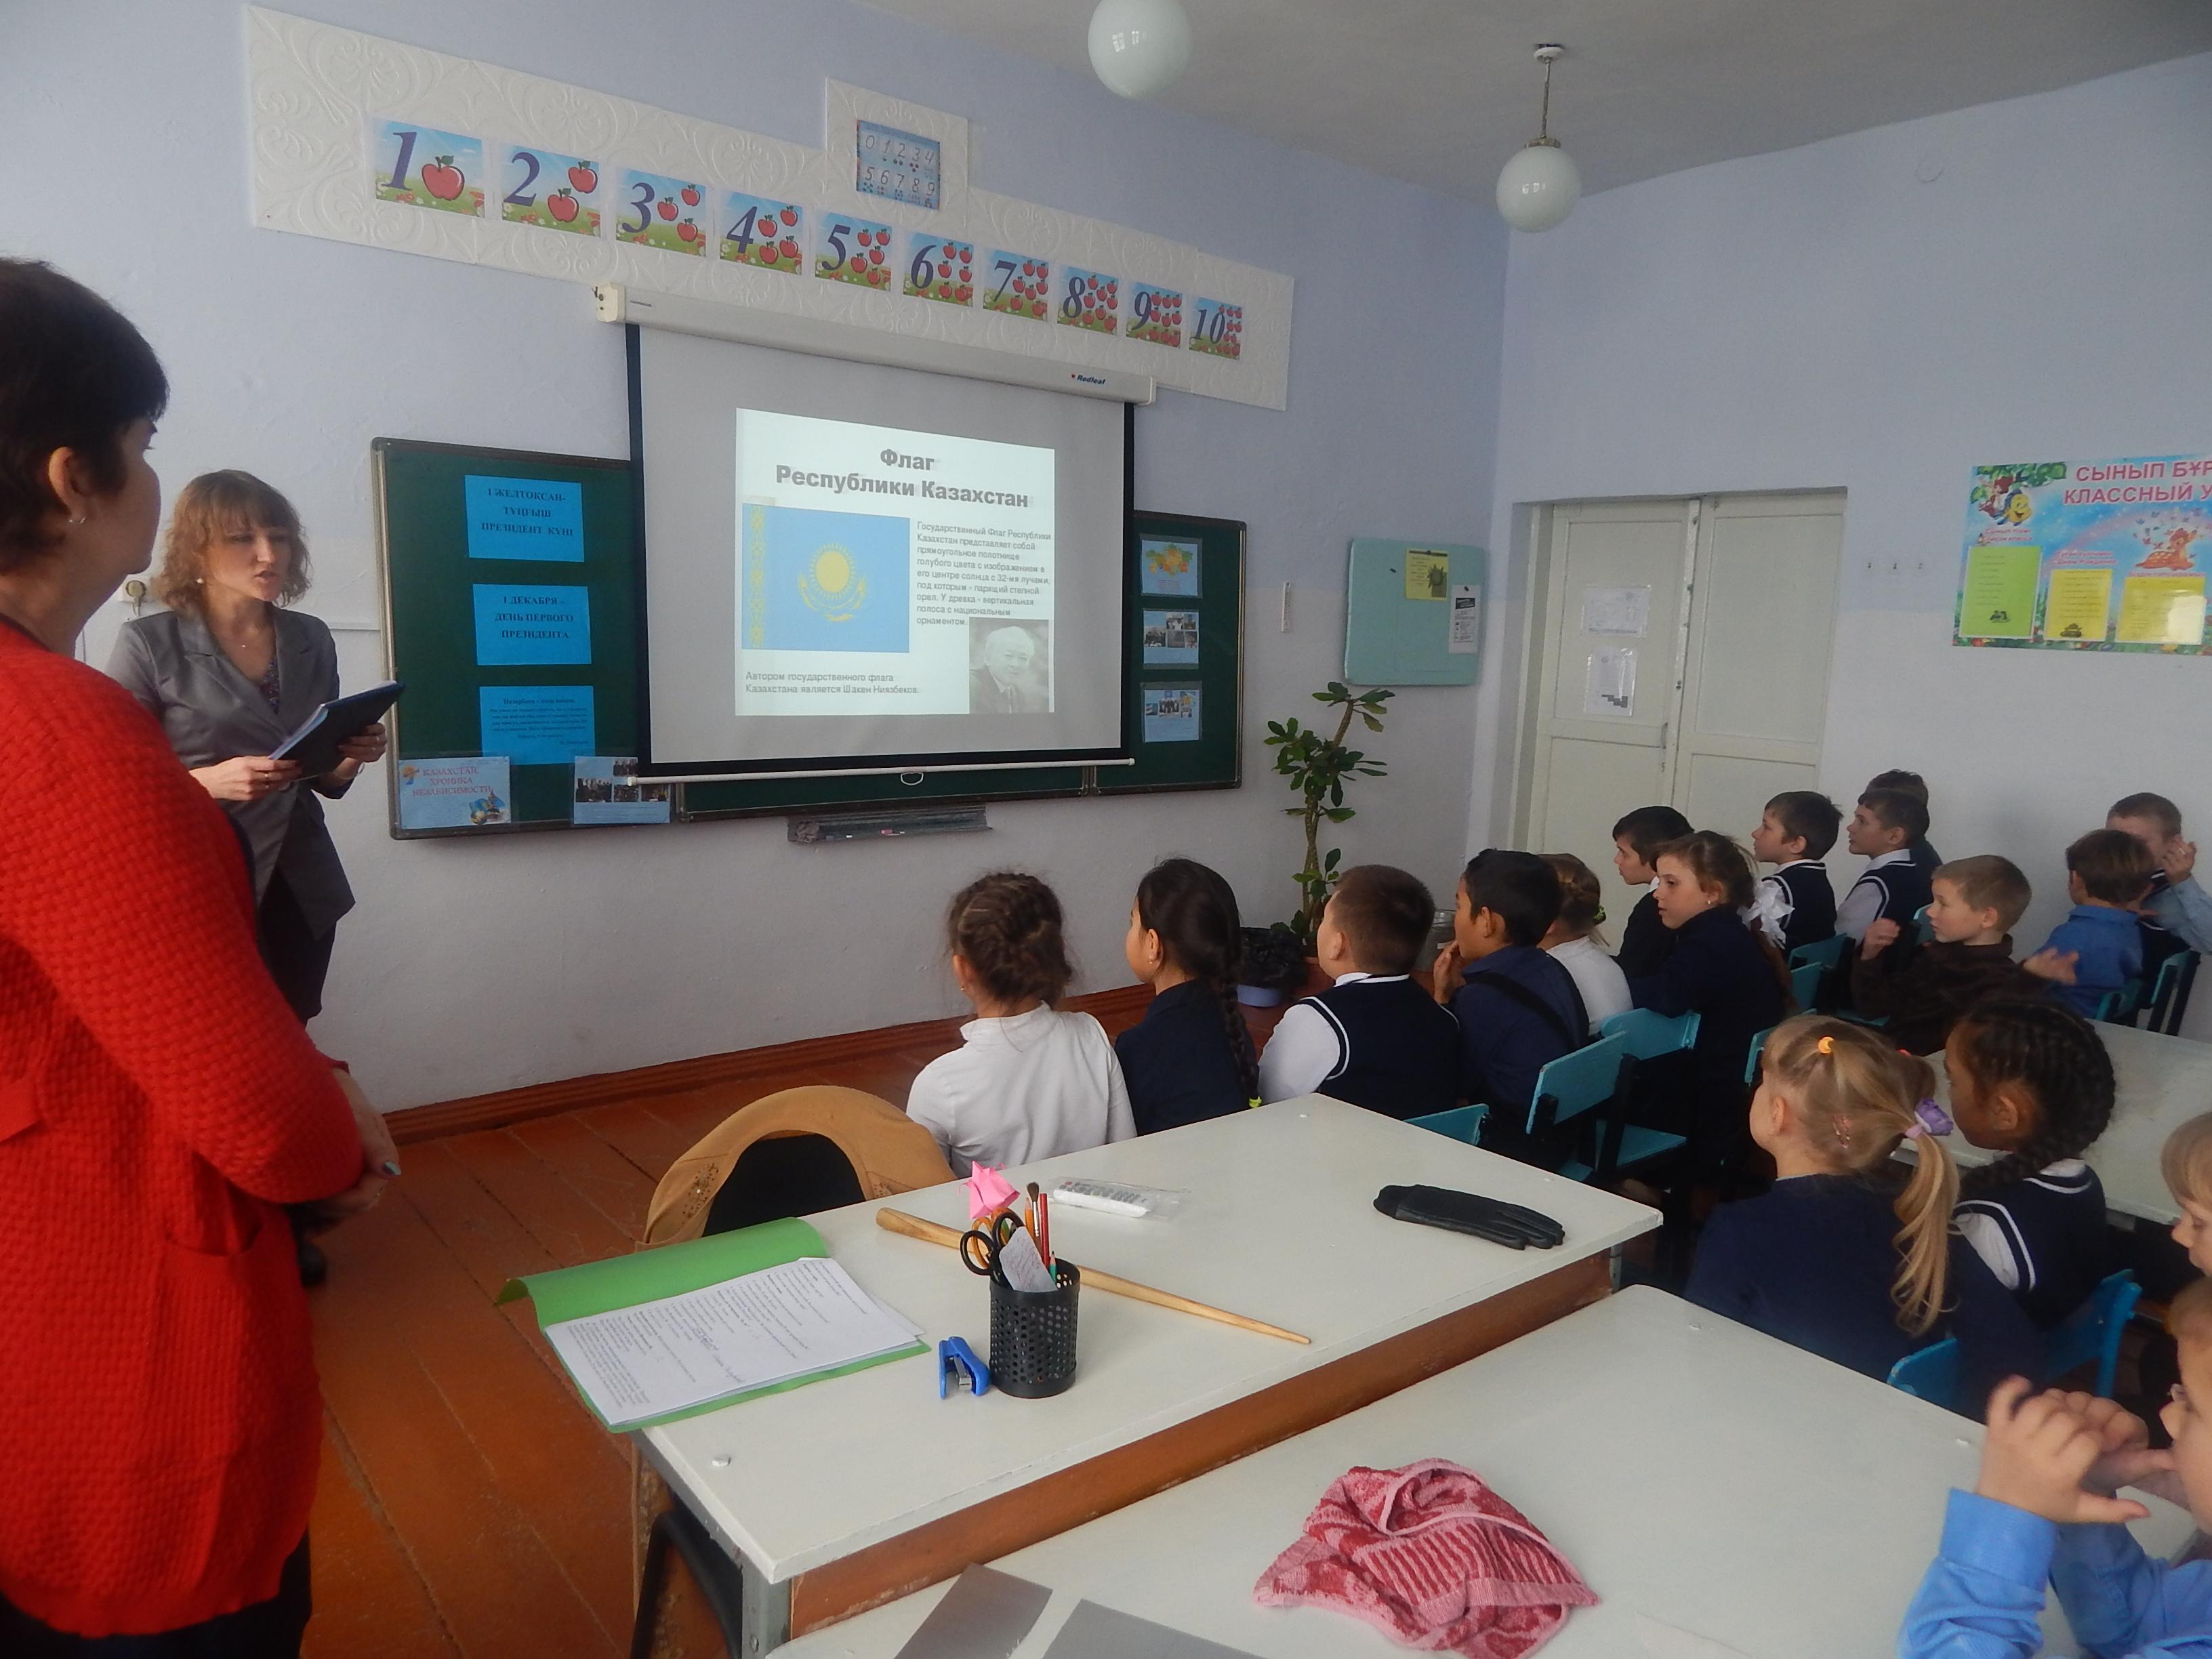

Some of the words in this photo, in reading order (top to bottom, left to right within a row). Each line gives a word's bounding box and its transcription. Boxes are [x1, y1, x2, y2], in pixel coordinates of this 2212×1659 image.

[381, 131, 417, 190] 1
[884, 140, 890, 153] 1
[897, 143, 905, 158] 2
[912, 147, 920, 161] 3
[925, 151, 934, 165] 4
[504, 152, 540, 207] 2
[865, 167, 874, 180] 5
[881, 170, 889, 184] 6
[897, 173, 905, 188] 7
[912, 178, 920, 192] 8
[927, 182, 935, 196] 9
[621, 182, 655, 233] 3
[726, 205, 758, 253] 4
[821, 224, 851, 270] 5
[910, 245, 937, 289] 6
[993, 260, 1017, 302] 7
[1062, 276, 1086, 318] 8
[1132, 291, 1152, 330] 9
[1191, 309, 1225, 345] 10
[1078, 375, 1106, 384] Redleaf
[880, 449, 935, 470] Флаг
[2076, 463, 2165, 481] СЫНЫП
[776, 464, 914, 496] Республики
[922, 480, 1028, 508] Казахстан
[2064, 482, 2193, 504] КЛАССНЫЙ
[917, 521, 986, 535] Государственный
[987, 527, 1006, 537] Флаг
[1008, 529, 1051, 541] Республики
[917, 533, 958, 544] Казахстан
[960, 538, 1011, 548] представляет
[1012, 541, 1036, 550] собой
[917, 546, 976, 557] прямоугольное
[978, 551, 1020, 561] полотнище
[917, 558, 951, 568] голубого
[954, 561, 975, 570] цвета
[984, 562, 1038, 573] изображением
[932, 571, 960, 581] центре
[961, 573, 989, 581] солнца
[997, 574, 1019, 583] 32-мя
[917, 582, 932, 590] под
[934, 583, 966, 592] которым
[974, 585, 1008, 594] парящий
[1010, 587, 1040, 595] степной
[510, 596, 558, 605] ДЕКАБРЯ
[917, 594, 938, 602] орел.
[941, 593, 946, 601] У
[949, 595, 976, 604] древка
[983, 597, 1034, 606] вертикальная
[495, 613, 523, 622] ДЕНЬ
[526, 613, 574, 622] ПЕРВОГО
[917, 605, 945, 613] полоса
[954, 607, 1010, 616] национальным
[917, 617, 967, 626] орнаментом.
[501, 630, 569, 639] ПРЕЗИДЕНТА
[745, 671, 785, 682] Автором
[788, 674, 866, 683] государственного
[868, 674, 894, 683] флага
[745, 684, 798, 693] Казахстана
[801, 685, 840, 693] является
[843, 685, 872, 693] Шакен
